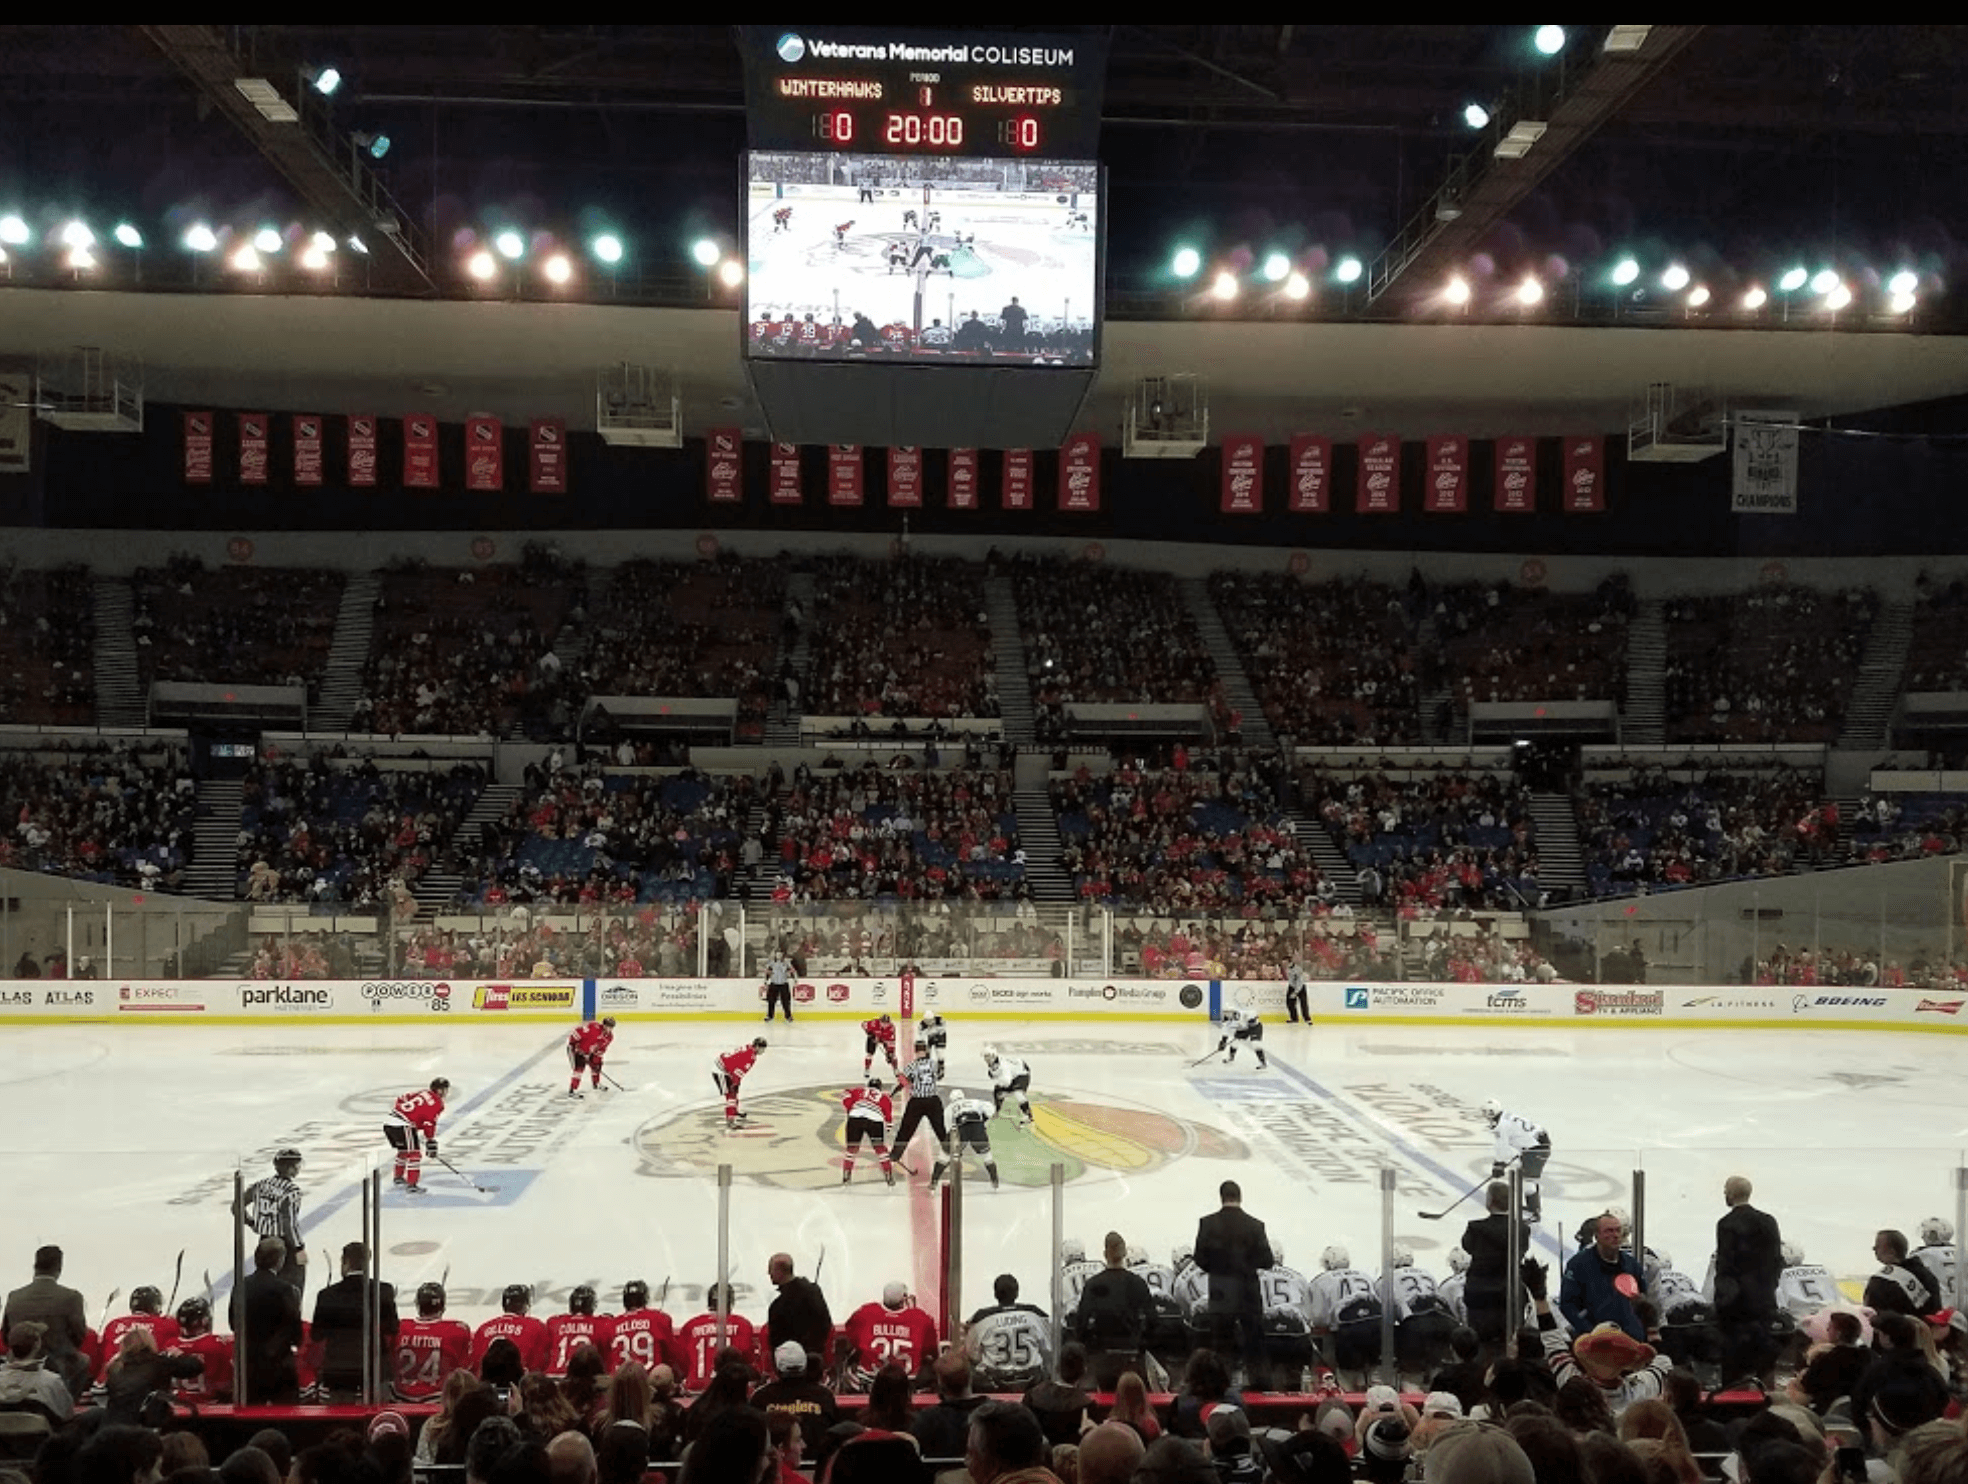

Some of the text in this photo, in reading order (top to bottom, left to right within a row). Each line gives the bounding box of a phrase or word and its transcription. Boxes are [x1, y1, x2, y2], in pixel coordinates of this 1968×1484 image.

[808, 39, 1074, 66] Veterans Memorial COLISEUM
[781, 79, 882, 98] WINTERHAWKS
[972, 85, 1062, 104] SILVERTIPS
[836, 112, 852, 140] 0
[887, 115, 963, 144] 20:00
[1022, 119, 1037, 147] 0
[45, 991, 94, 1005] ATLAS
[242, 986, 328, 1007] parklane
[1373, 988, 1408, 997] PACIFIC
[1373, 996, 1437, 1005] AUTOMATION
[1815, 996, 1887, 1006] BOEING
[431, 999, 450, 1012] 85
[399, 1348, 441, 1386] 24
